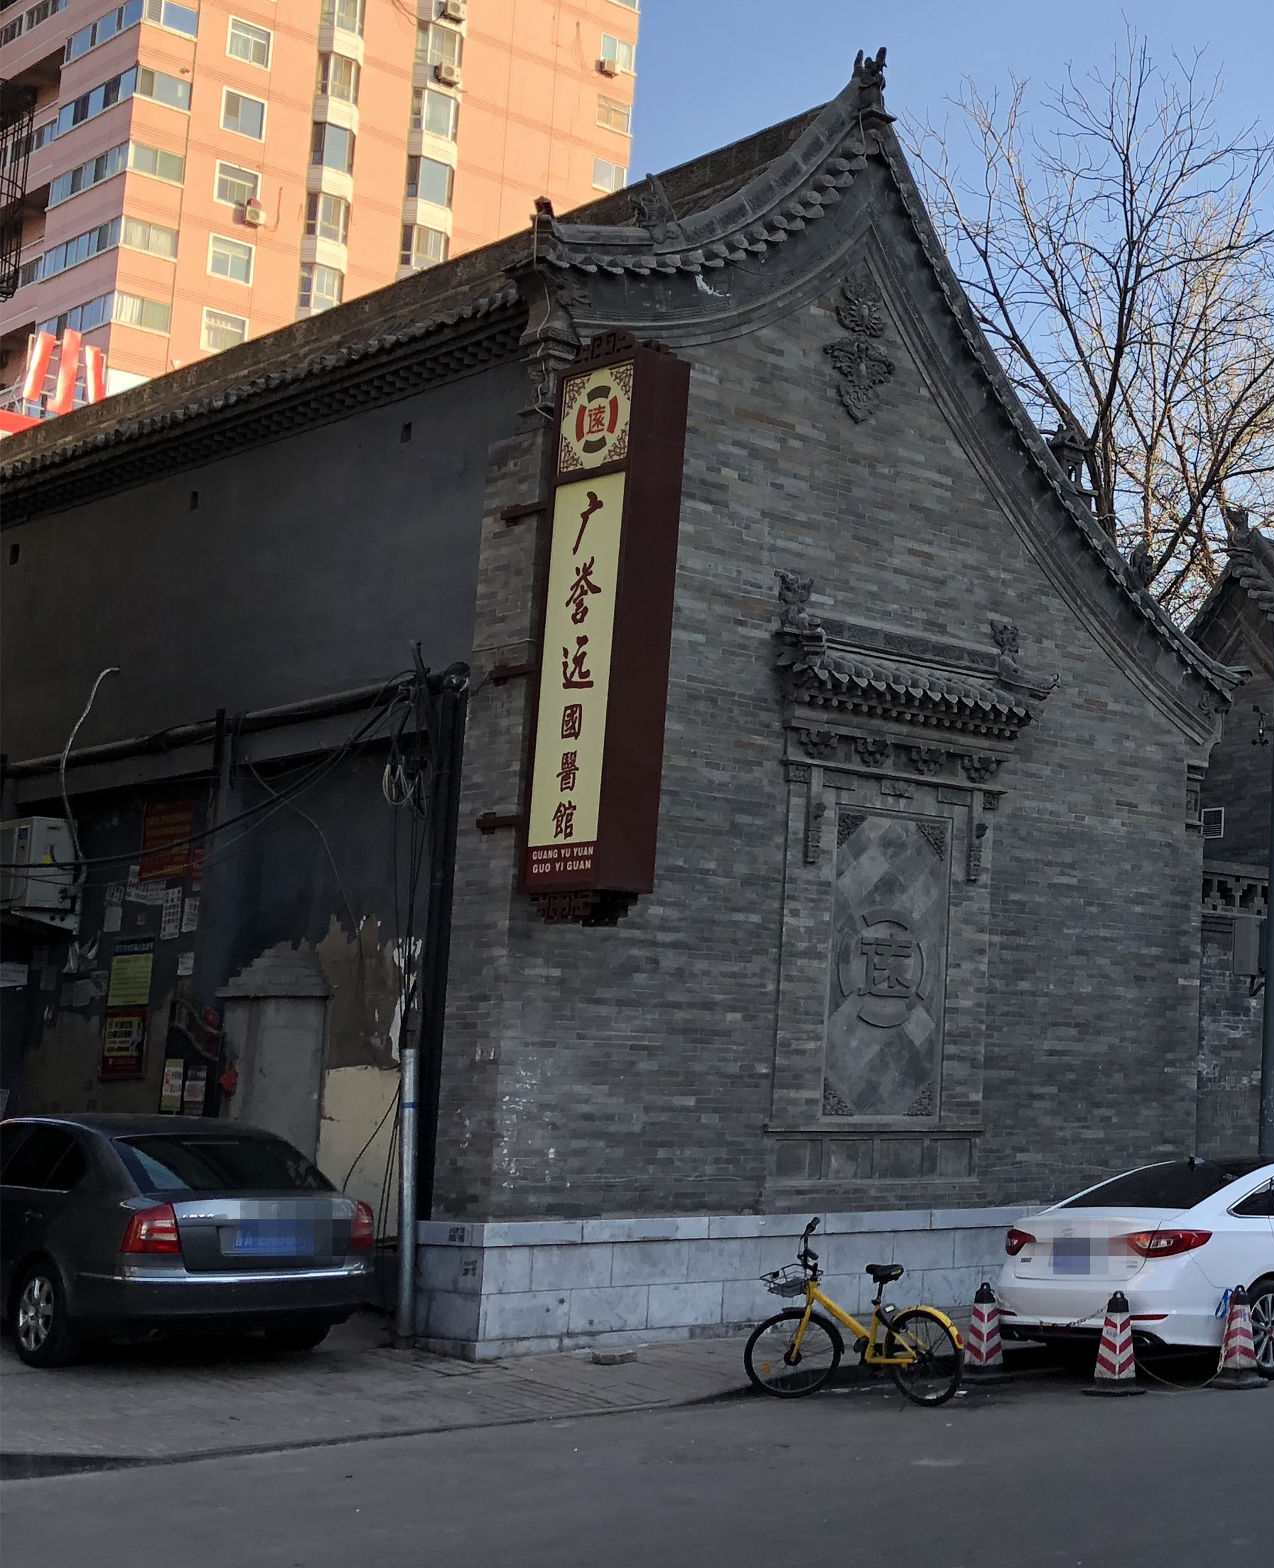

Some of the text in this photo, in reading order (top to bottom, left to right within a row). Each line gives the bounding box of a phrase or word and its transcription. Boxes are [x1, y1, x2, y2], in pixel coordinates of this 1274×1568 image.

[532, 846, 594, 860] GUANG YU YUAN
[532, 859, 592, 873] GUO YI GUAN
